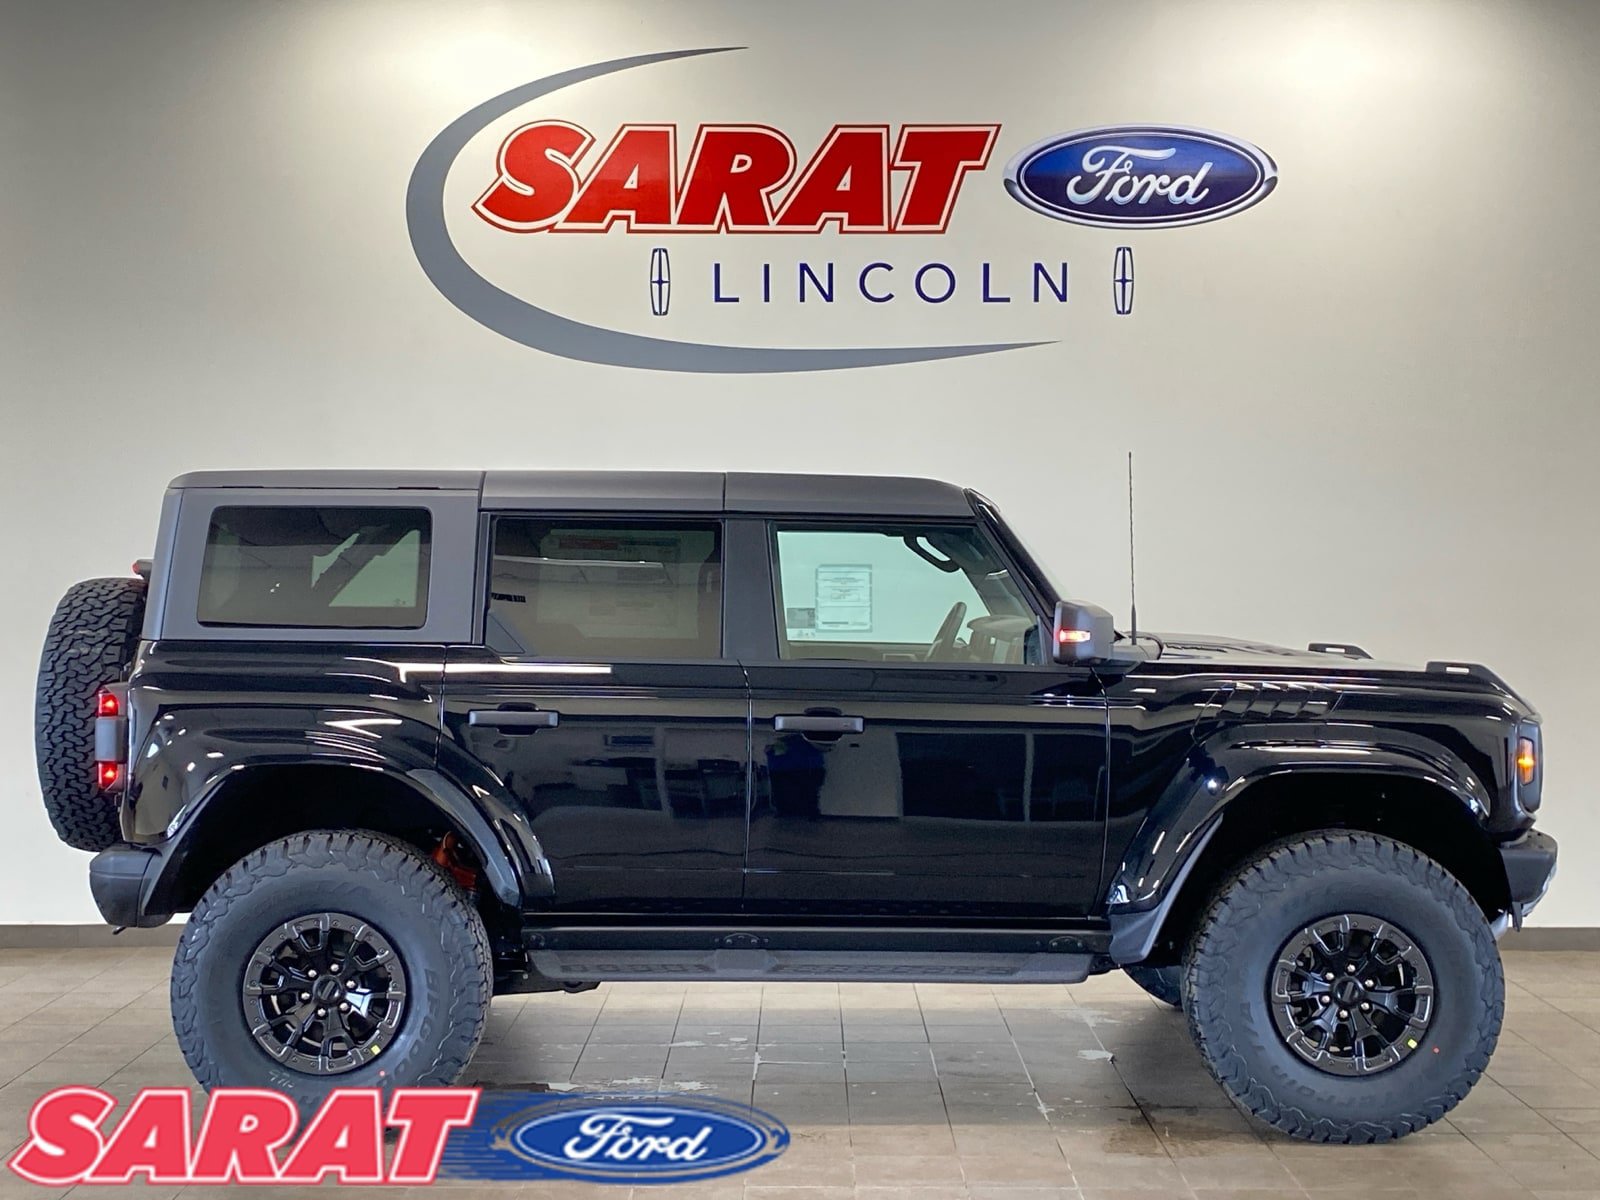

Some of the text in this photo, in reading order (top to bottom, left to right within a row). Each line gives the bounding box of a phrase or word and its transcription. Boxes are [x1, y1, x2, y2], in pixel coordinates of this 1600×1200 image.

[471, 120, 1213, 234] SARAT Ford
[714, 263, 1067, 303] LINCOLN
